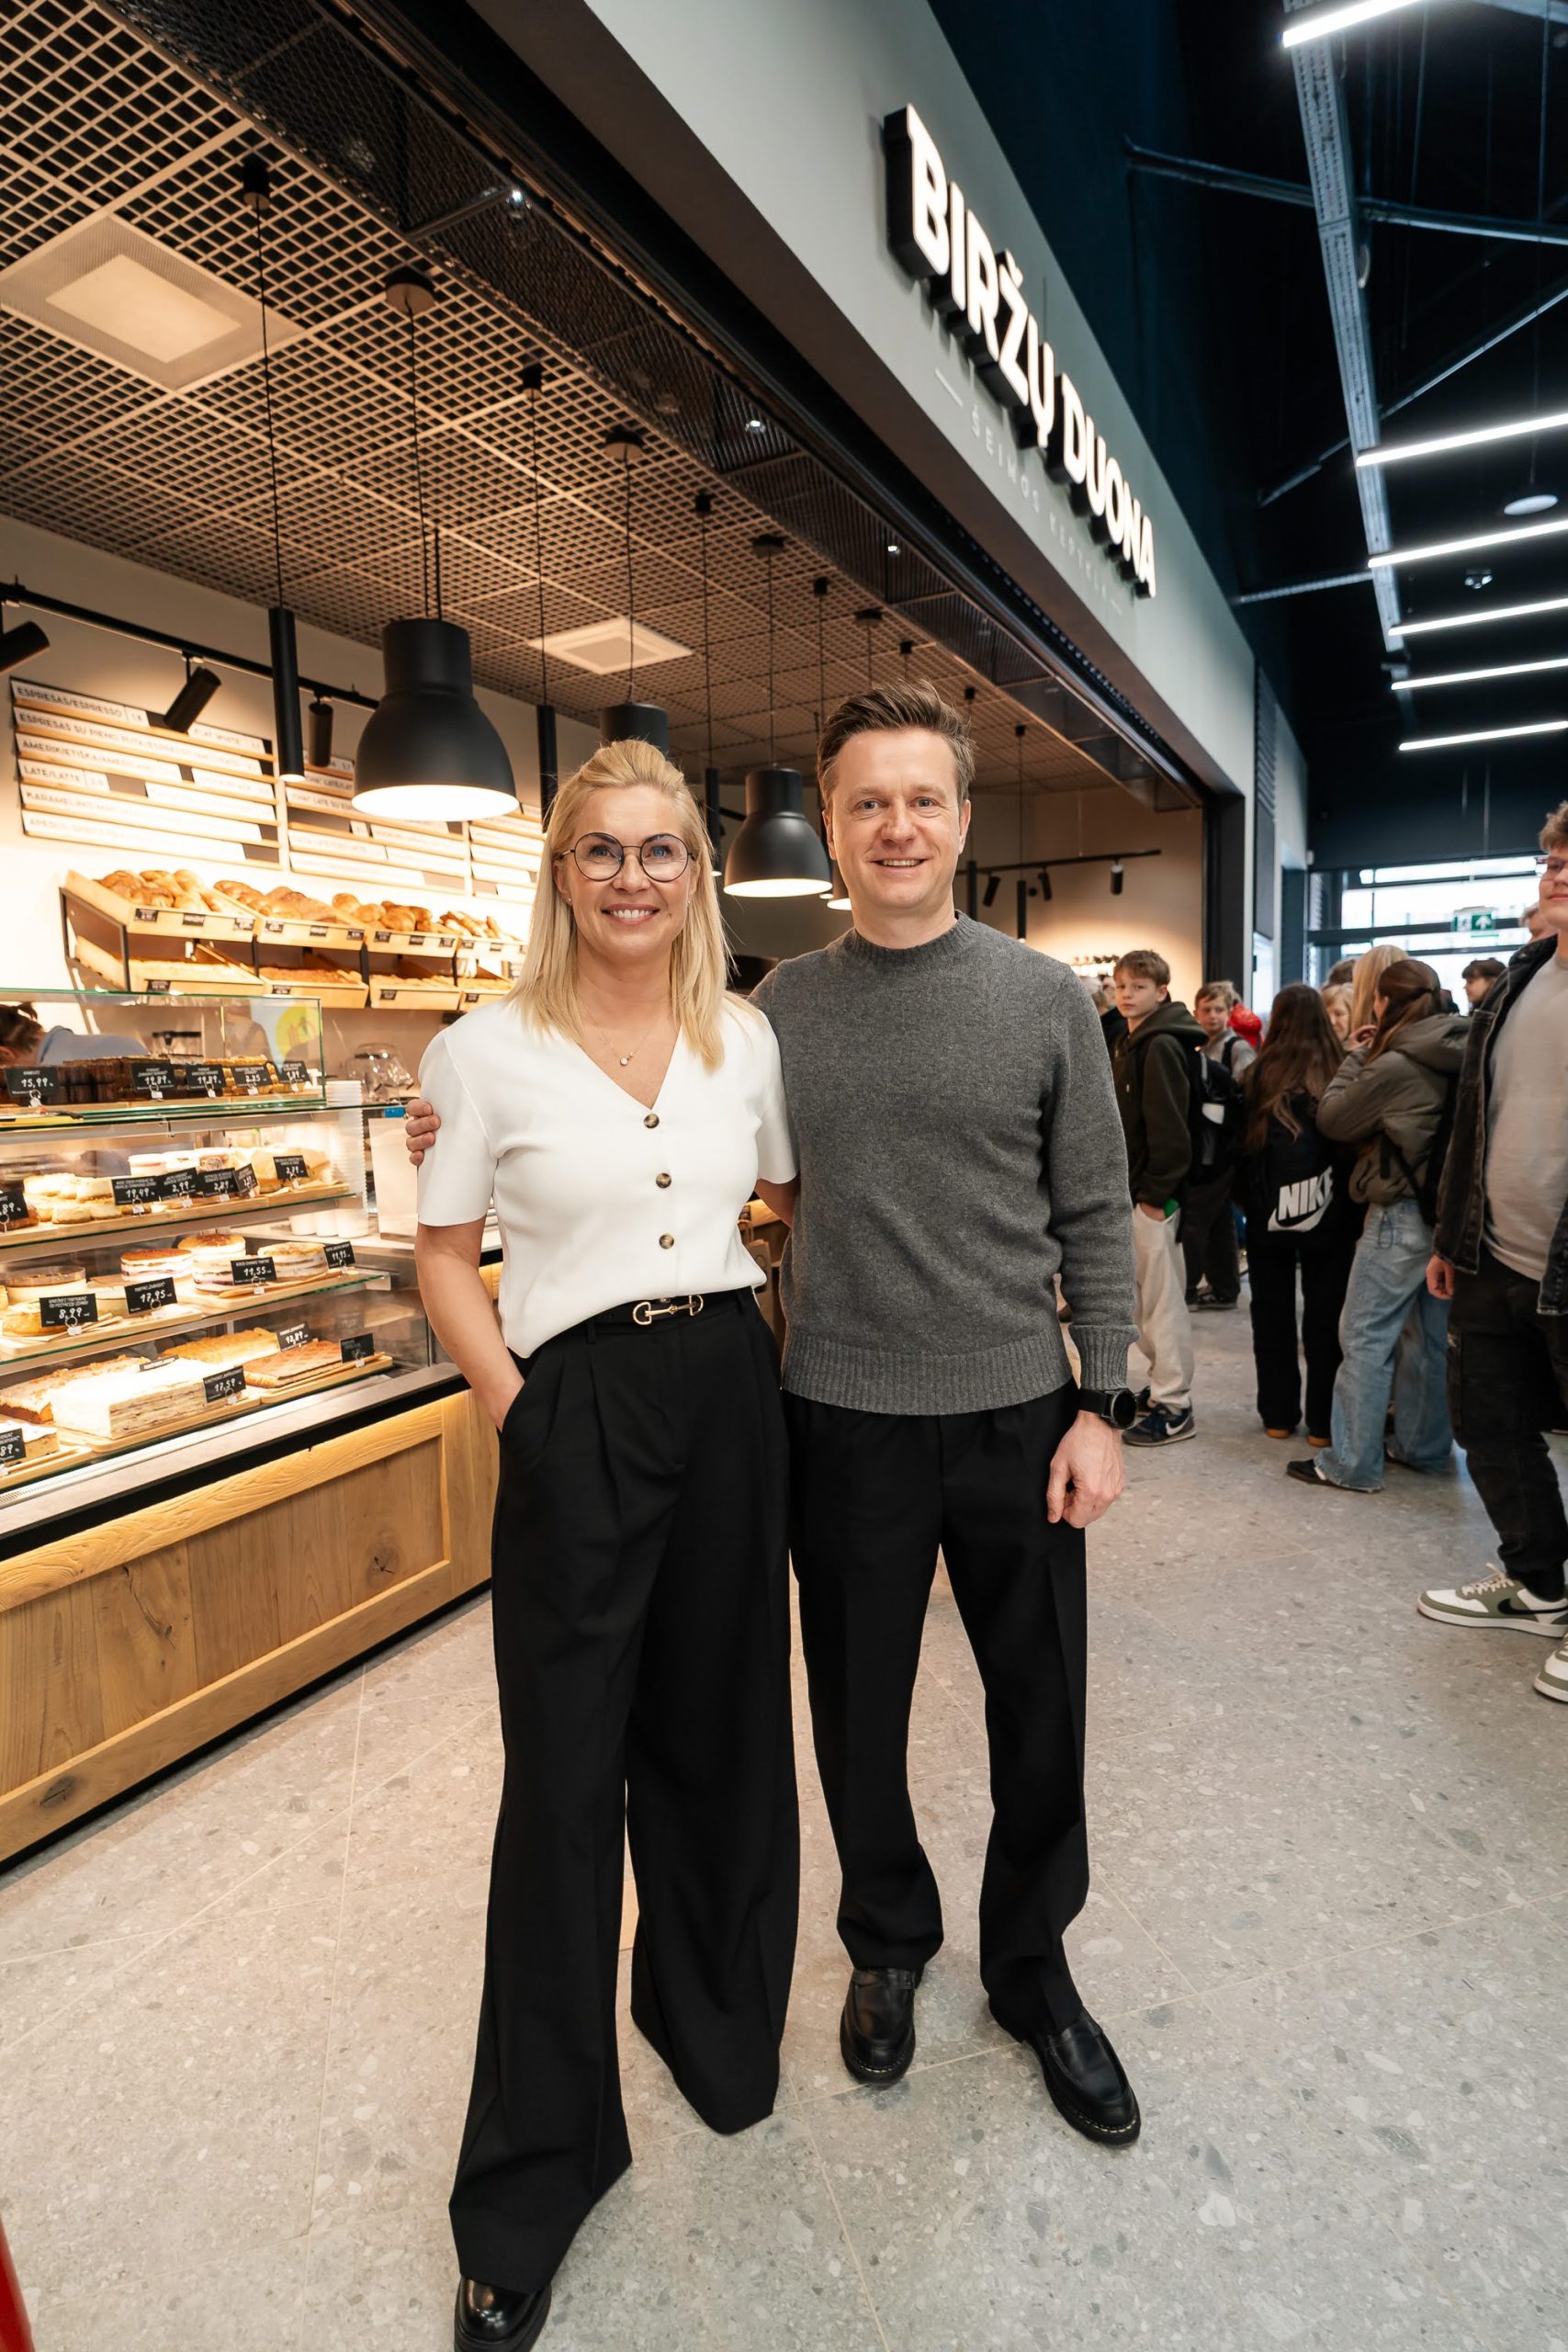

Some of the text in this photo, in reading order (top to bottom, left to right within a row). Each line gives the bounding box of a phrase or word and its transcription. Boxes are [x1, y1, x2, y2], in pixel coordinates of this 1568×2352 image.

[907, 103, 1156, 598] BIRŽŲ DUONA
[970, 404, 1040, 514] ŠEIMOS
[21, 1077, 49, 1089] 15,99
[1278, 1165, 1333, 1221] NIKE
